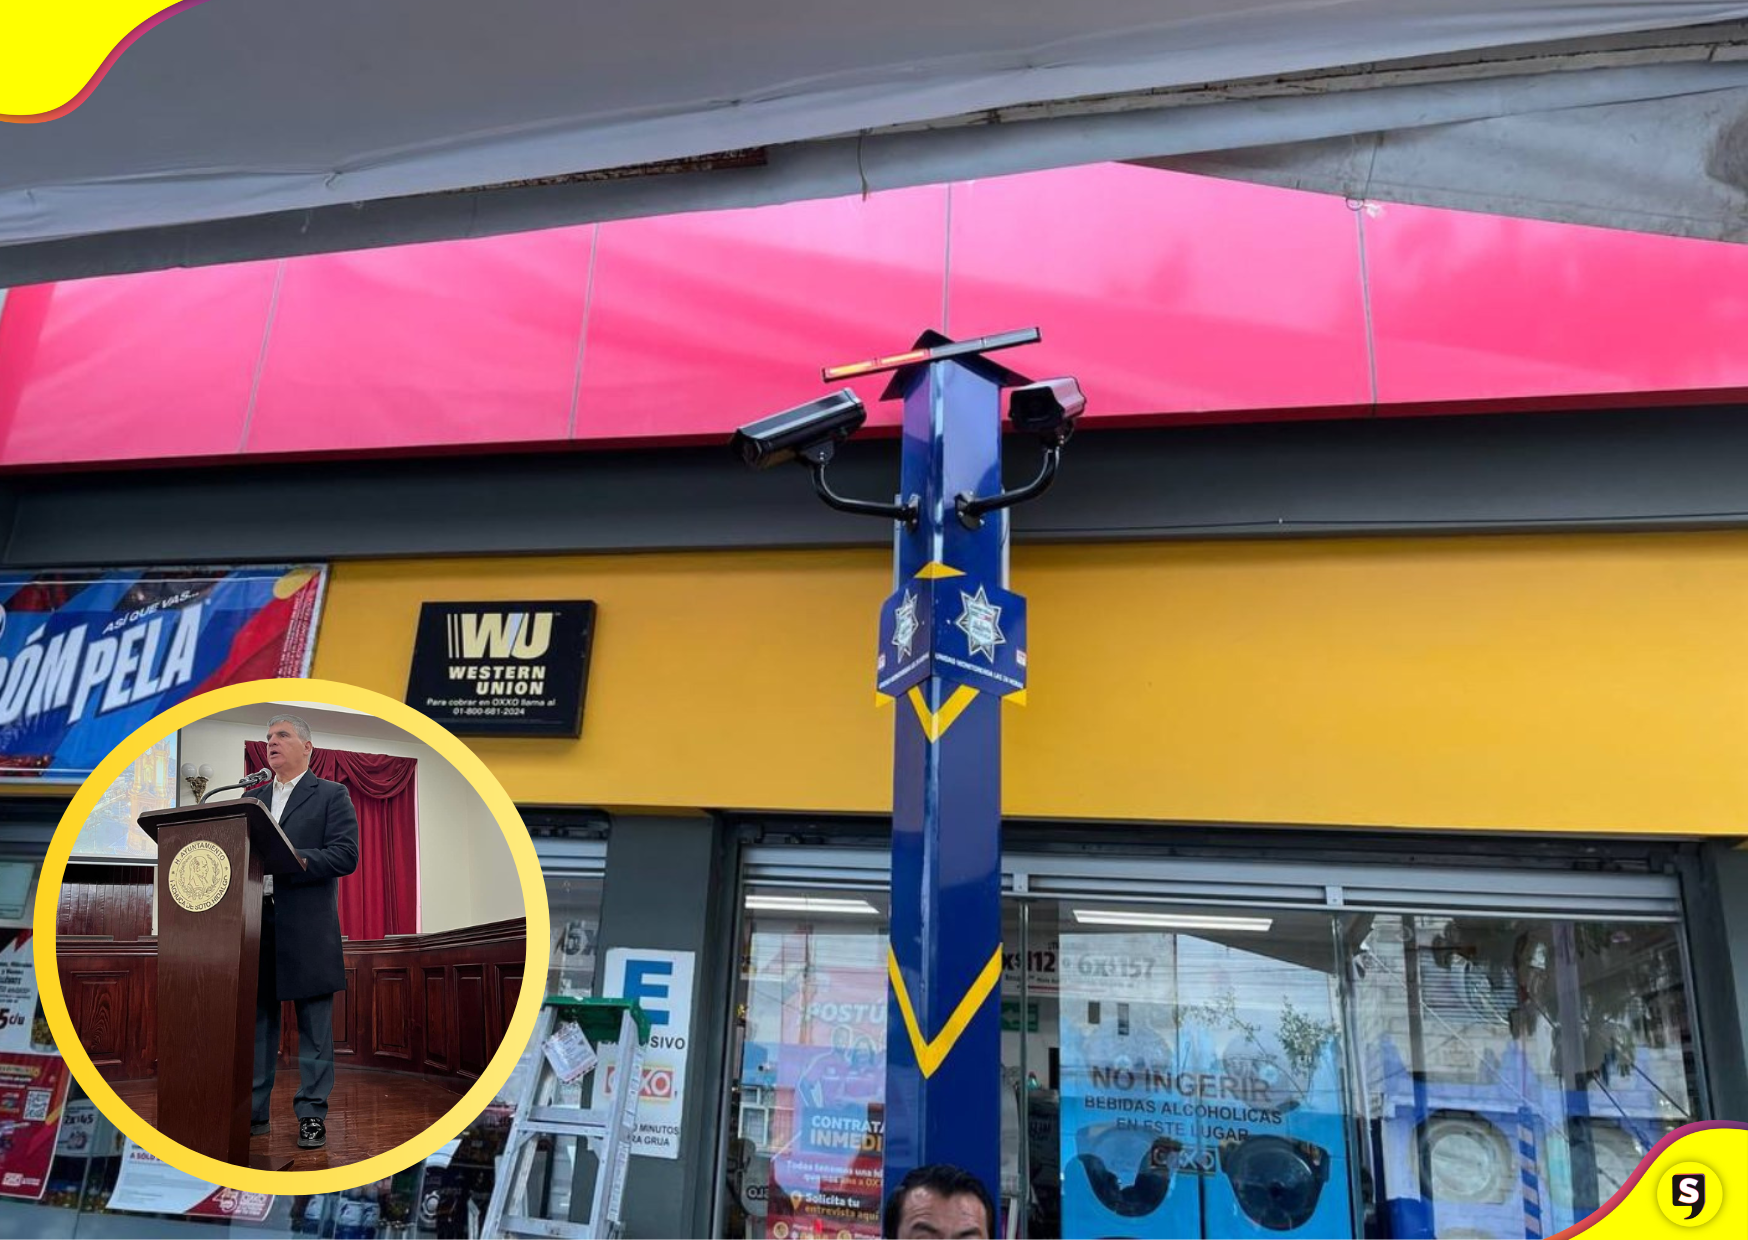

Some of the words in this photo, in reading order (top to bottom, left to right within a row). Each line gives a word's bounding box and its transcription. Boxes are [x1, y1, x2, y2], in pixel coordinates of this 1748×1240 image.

[130, 602, 160, 622] QUE
[460, 612, 554, 660] WU
[448, 665, 547, 680] WESTERN
[476, 681, 544, 695] UNION
[426, 697, 447, 706] Para
[448, 698, 477, 706] cobrar
[491, 698, 520, 706] OXXO
[180, 842, 226, 861] AYUNTAMIENTO
[1092, 1065, 1136, 1090] NO
[1145, 1069, 1272, 1103] INGERIR
[1084, 1095, 1156, 1114] BEBIDAS
[1160, 1102, 1283, 1125] ALCOHOLICAS
[639, 1123, 679, 1136] MINUTOS
[1116, 1117, 1138, 1131] EN
[1143, 1119, 1185, 1137] ESTE
[643, 1135, 671, 1147] GRUA
[805, 1193, 845, 1206] Solicita
[847, 1195, 861, 1209] tu
[804, 1204, 856, 1218] entrevista
